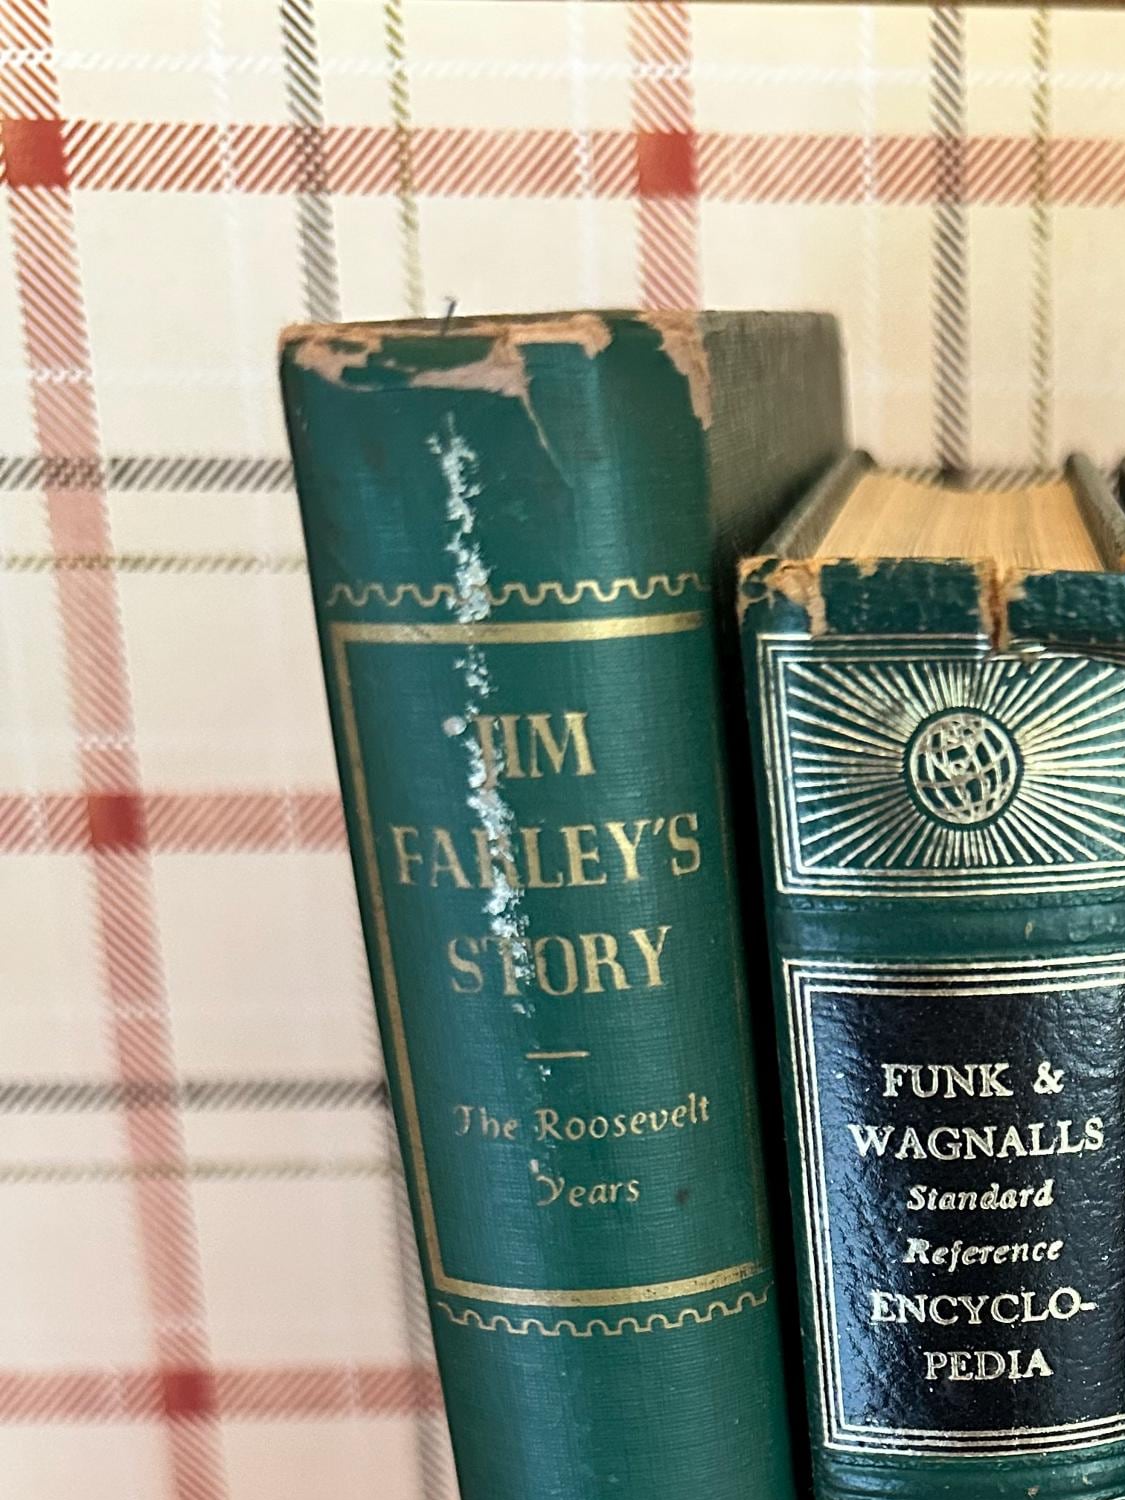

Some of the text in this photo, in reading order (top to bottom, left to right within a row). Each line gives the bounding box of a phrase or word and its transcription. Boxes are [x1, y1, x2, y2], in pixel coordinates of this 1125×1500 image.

[447, 925, 672, 997] STORY
[881, 1061, 1064, 1097] FUNK &
[453, 1093, 710, 1142] The Roosevelt
[848, 1116, 1105, 1160] WAGNALLS
[536, 1174, 640, 1207] Years
[907, 1178, 1055, 1211] Standard
[902, 1238, 1064, 1272] Reference
[869, 1287, 1098, 1326] ENCYCLO-
[923, 1348, 1055, 1382] PEDIA
